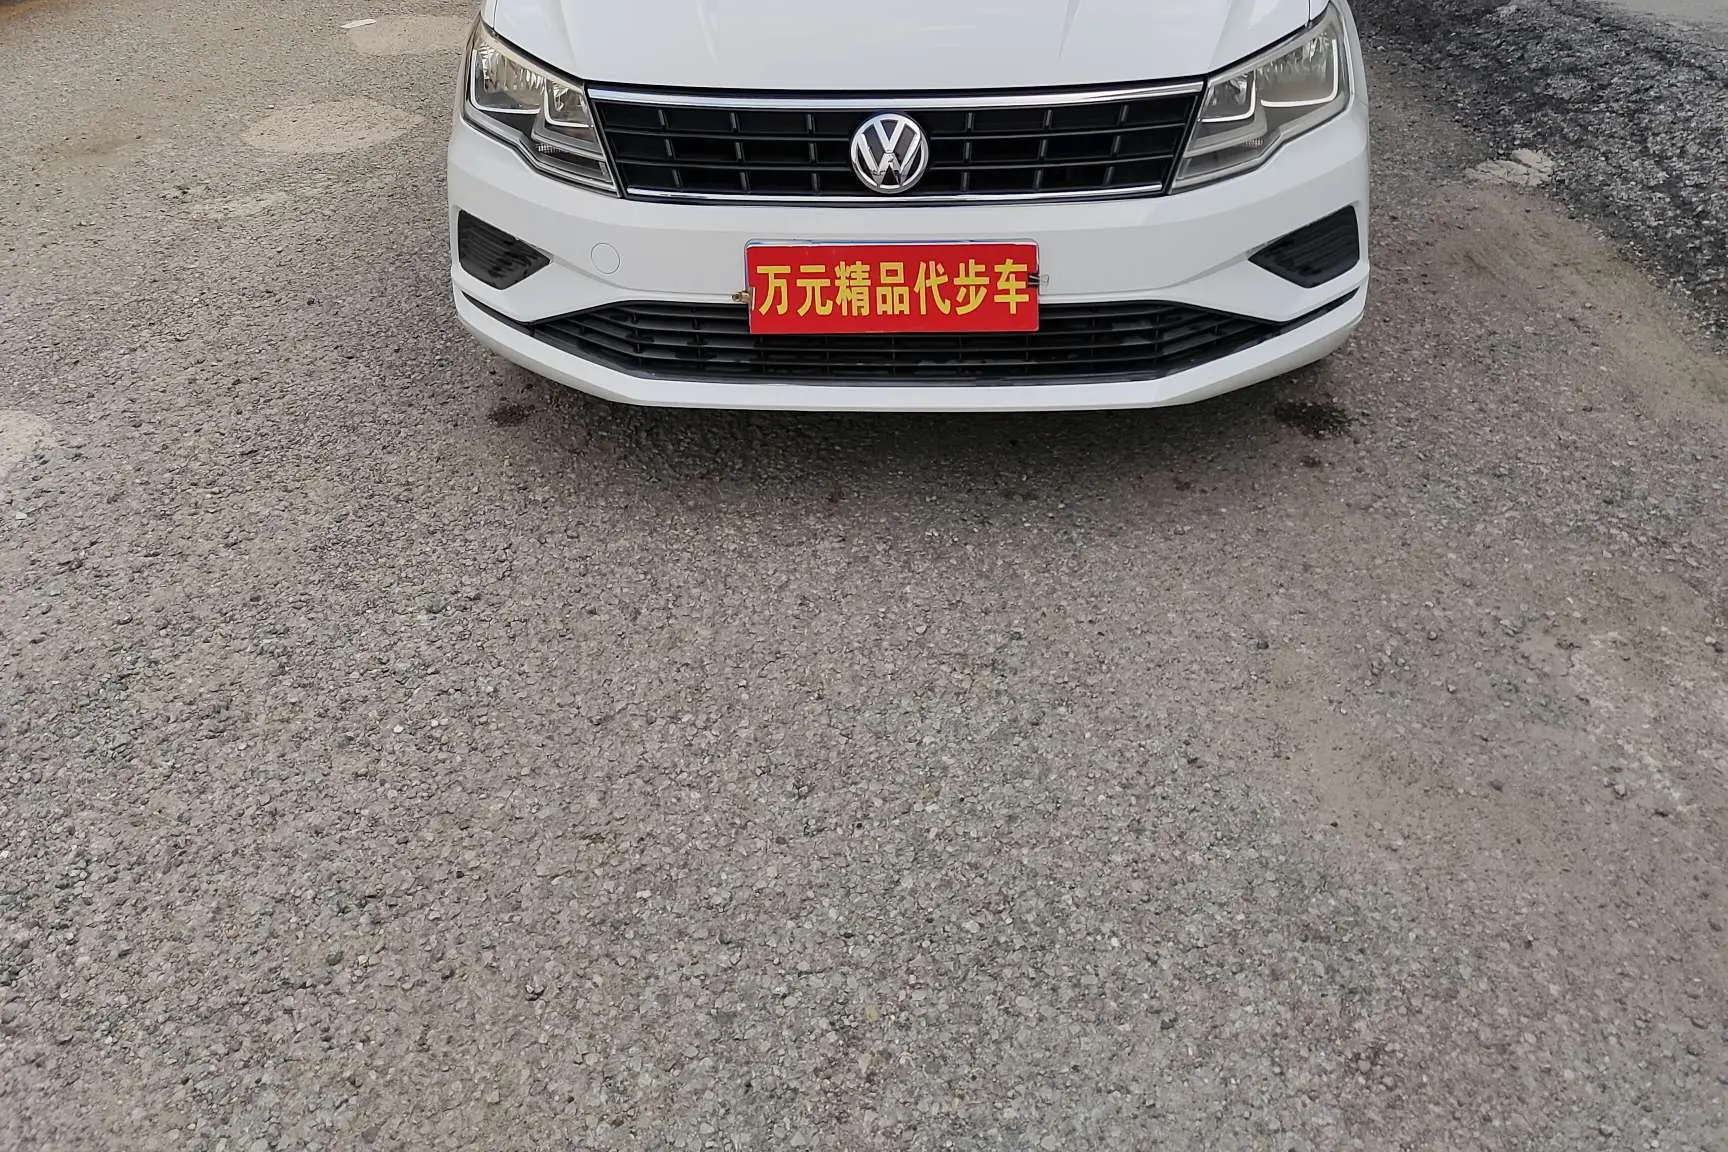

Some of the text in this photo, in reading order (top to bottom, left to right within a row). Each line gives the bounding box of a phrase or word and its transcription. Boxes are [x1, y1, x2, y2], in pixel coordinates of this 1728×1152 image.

[855, 117, 924, 188] VW
[754, 258, 1031, 317] 万元精品代步车
